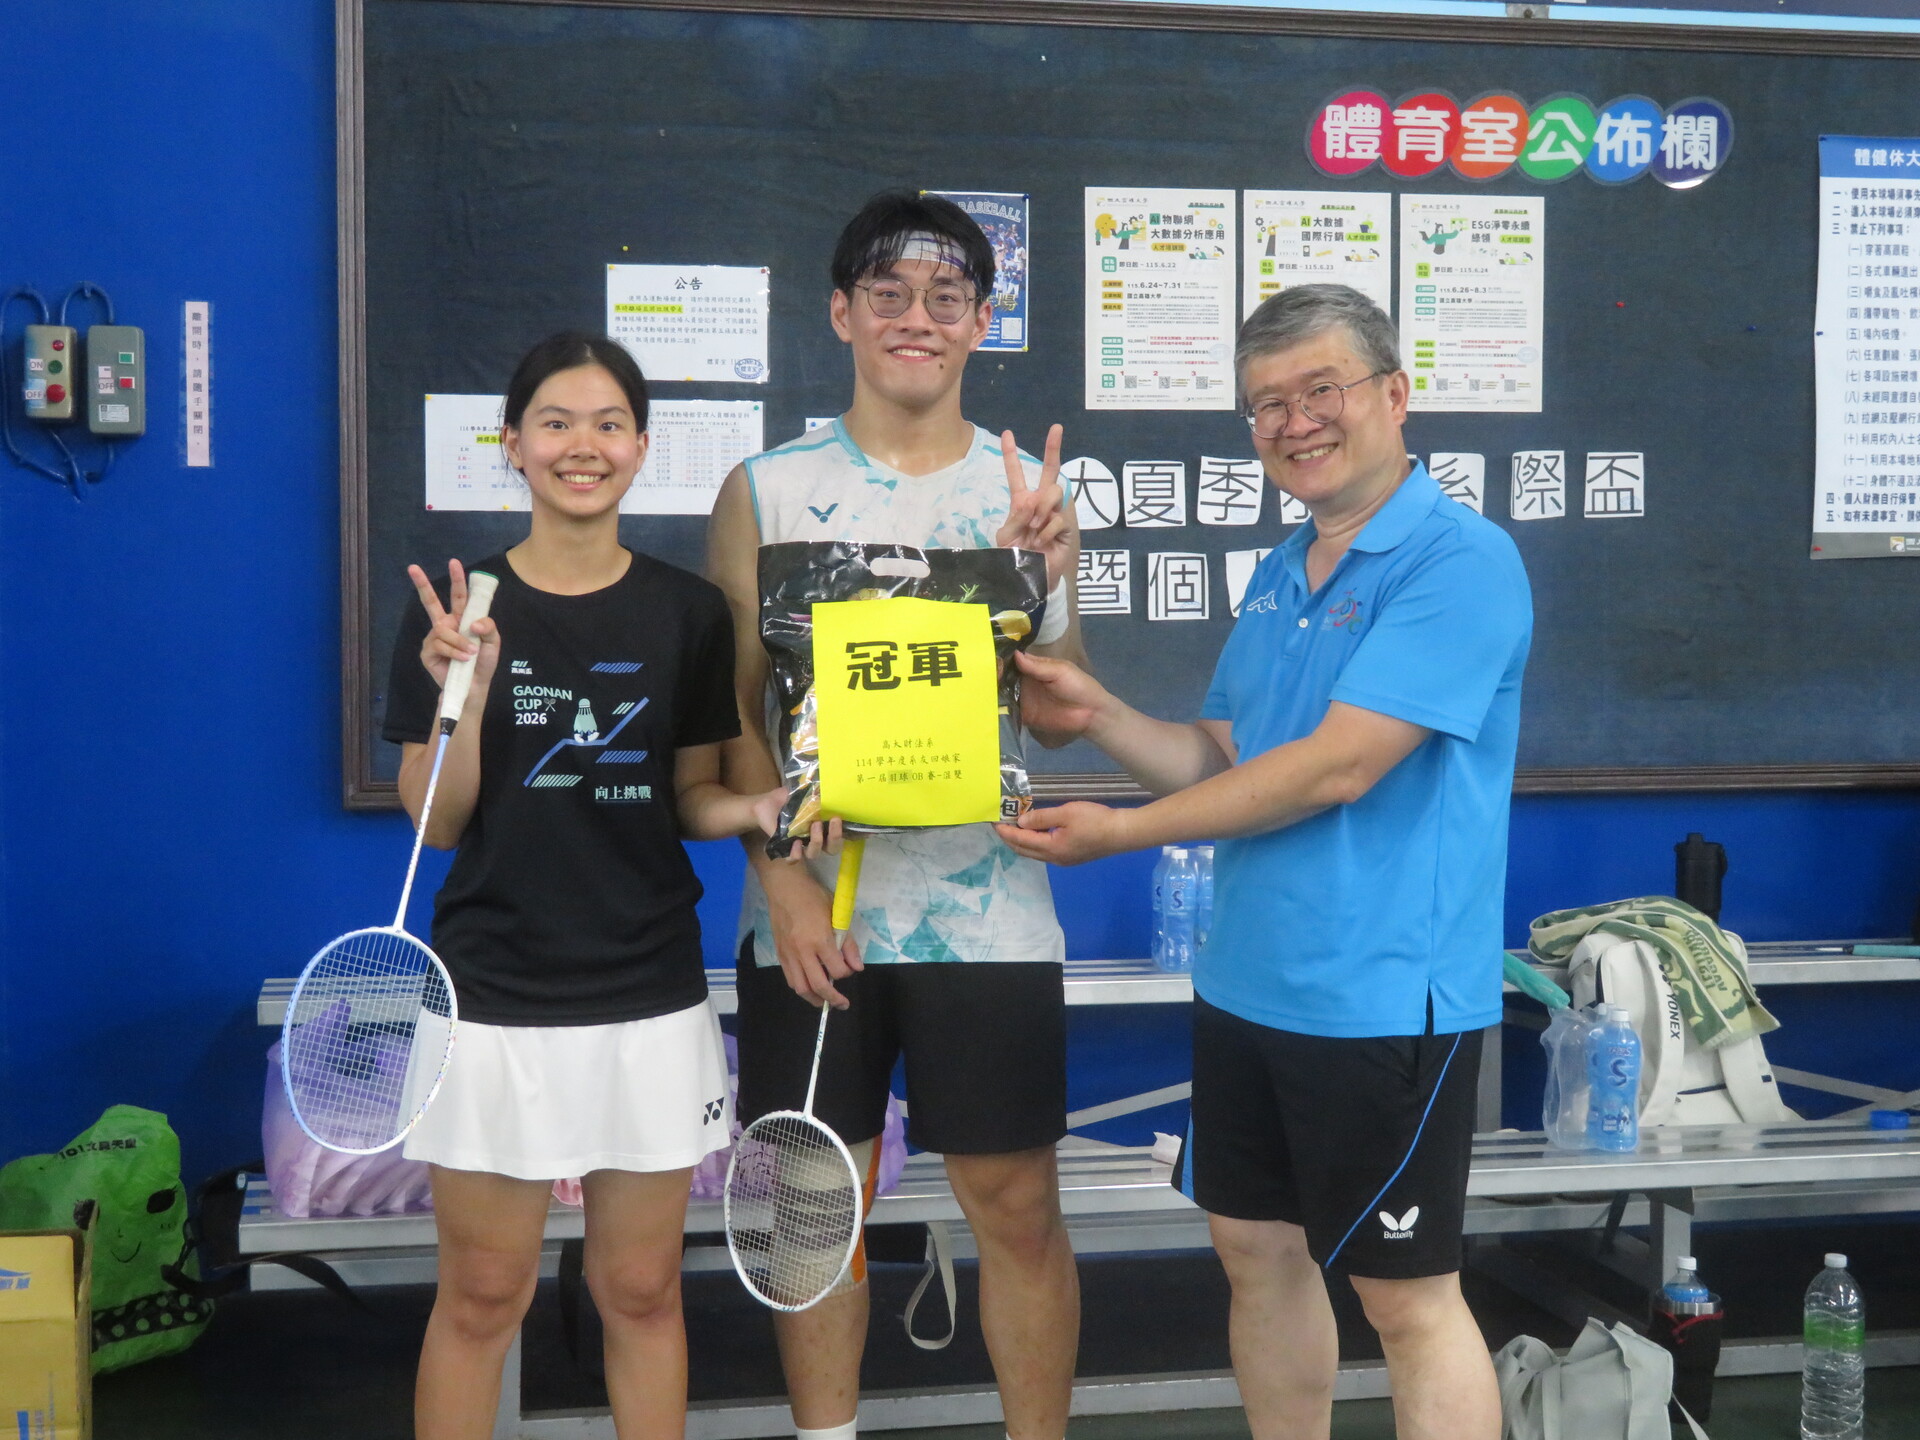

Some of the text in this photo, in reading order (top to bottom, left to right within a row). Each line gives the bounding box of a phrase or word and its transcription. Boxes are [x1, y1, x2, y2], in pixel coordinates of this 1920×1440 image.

[1323, 103, 1718, 170] 體育室公佈欄
[957, 200, 1022, 223] BASEBALL
[1301, 217, 1344, 227] AI 大數據
[1151, 229, 1225, 240] 大數據分析應用
[1301, 231, 1345, 242] 國際行銷
[674, 276, 703, 290] 公告
[30, 361, 43, 369] ON
[26, 390, 43, 398] OFF
[845, 640, 962, 690] 冠軍
[513, 685, 573, 700] GAONAN
[514, 699, 542, 710] CUP
[515, 712, 547, 725] 2026
[882, 738, 934, 749] 高大財法系
[856, 753, 962, 767] 114 學年度系友回娘家
[595, 786, 652, 800] 向上挑戰
[1666, 992, 1681, 1040] YONEX
[1383, 1230, 1414, 1239] Butterfly
